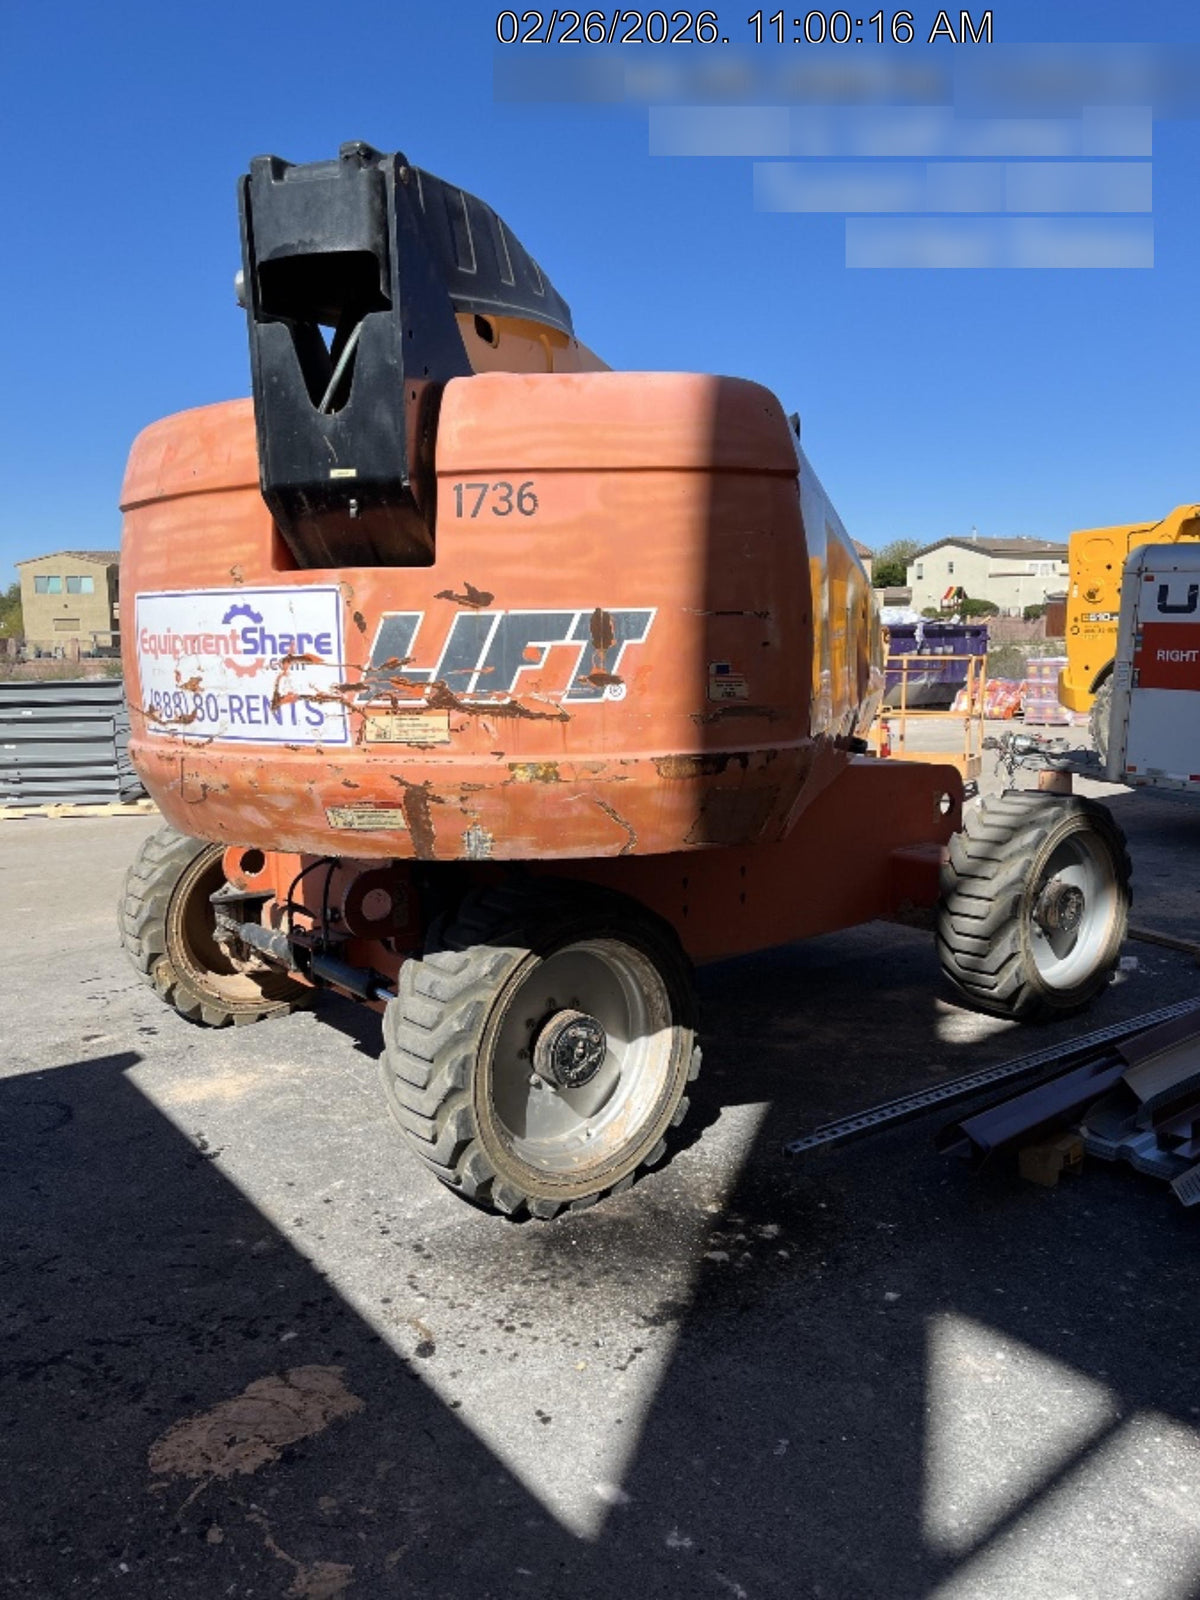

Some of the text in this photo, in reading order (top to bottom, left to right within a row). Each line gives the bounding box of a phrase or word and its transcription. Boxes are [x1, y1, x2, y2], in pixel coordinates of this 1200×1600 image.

[453, 482, 539, 518] 1736
[140, 626, 333, 659] EquipmentShare
[1156, 649, 1199, 662] RIGHT
